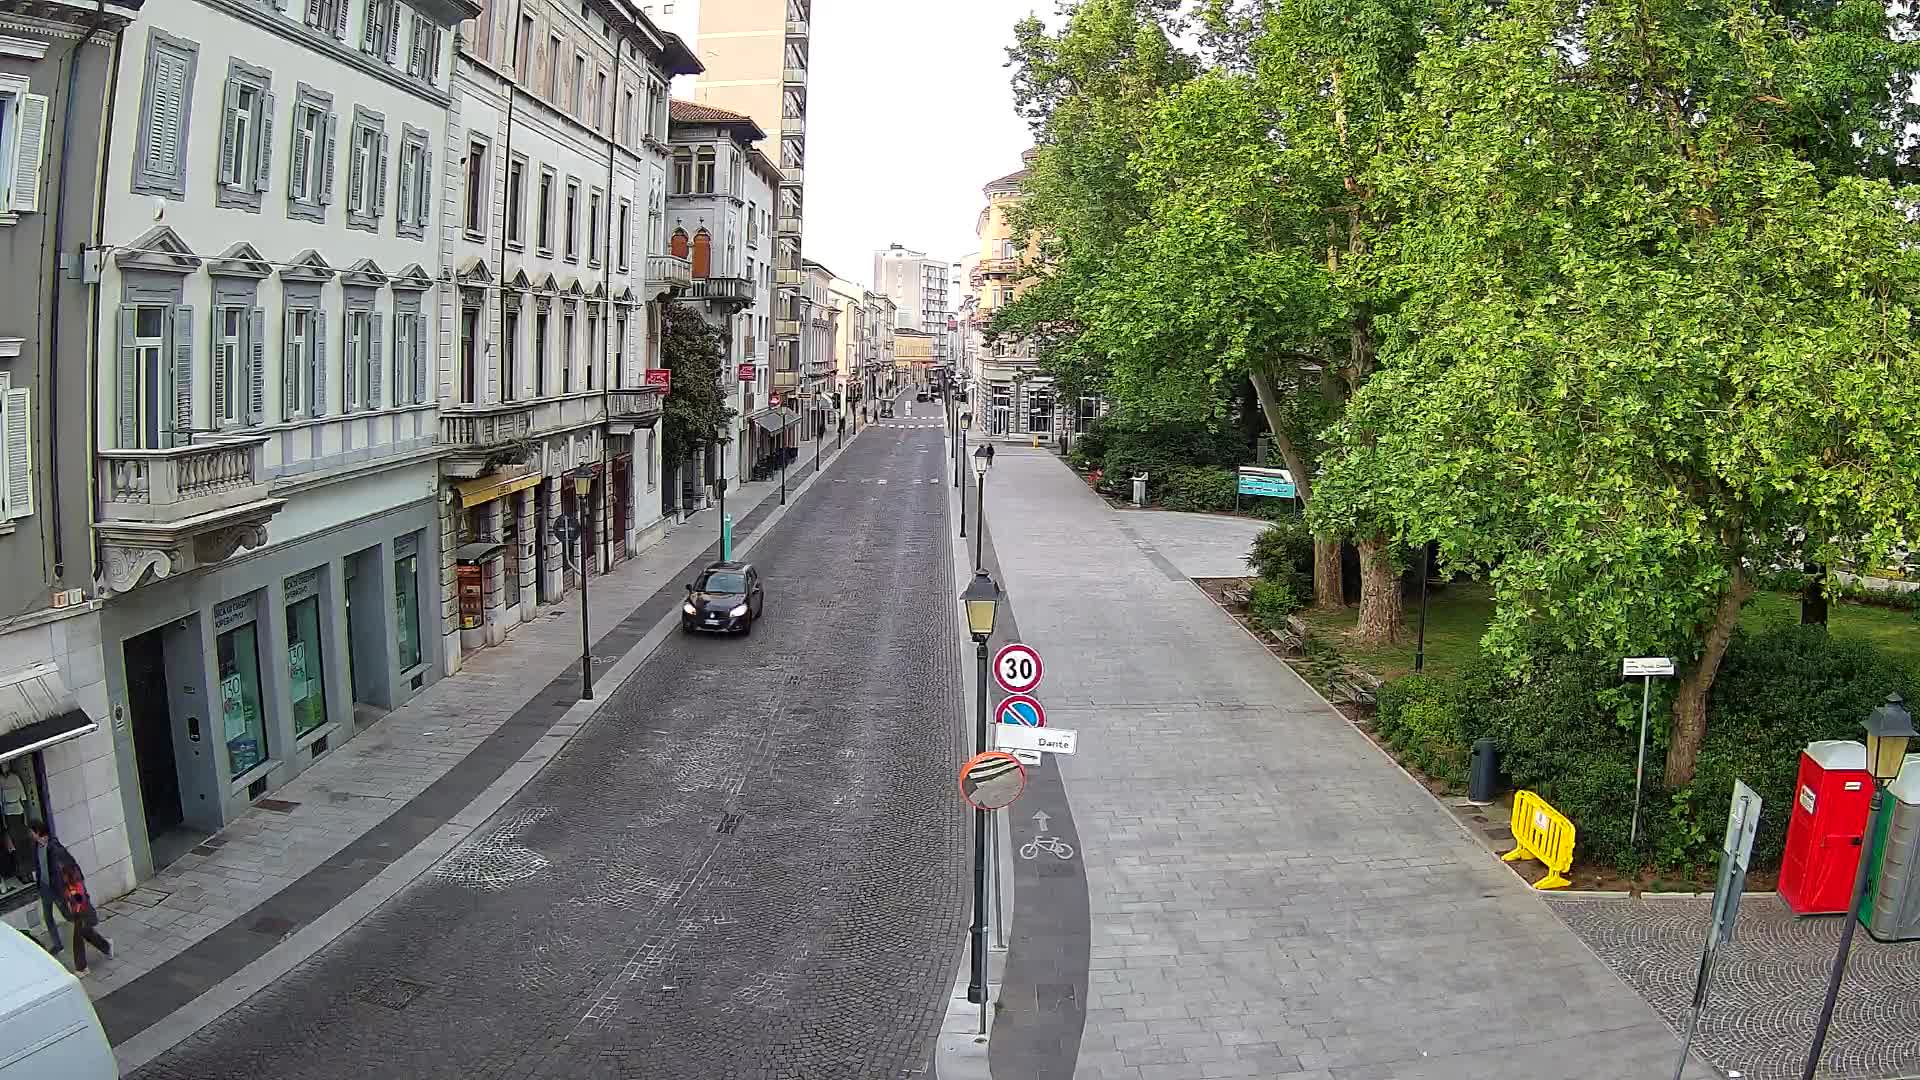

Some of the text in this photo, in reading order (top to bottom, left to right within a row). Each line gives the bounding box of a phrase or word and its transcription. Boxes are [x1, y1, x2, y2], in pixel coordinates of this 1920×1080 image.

[1005, 658, 1032, 679] 30
[222, 677, 240, 700] 130
[1038, 737, 1069, 749] Dante
